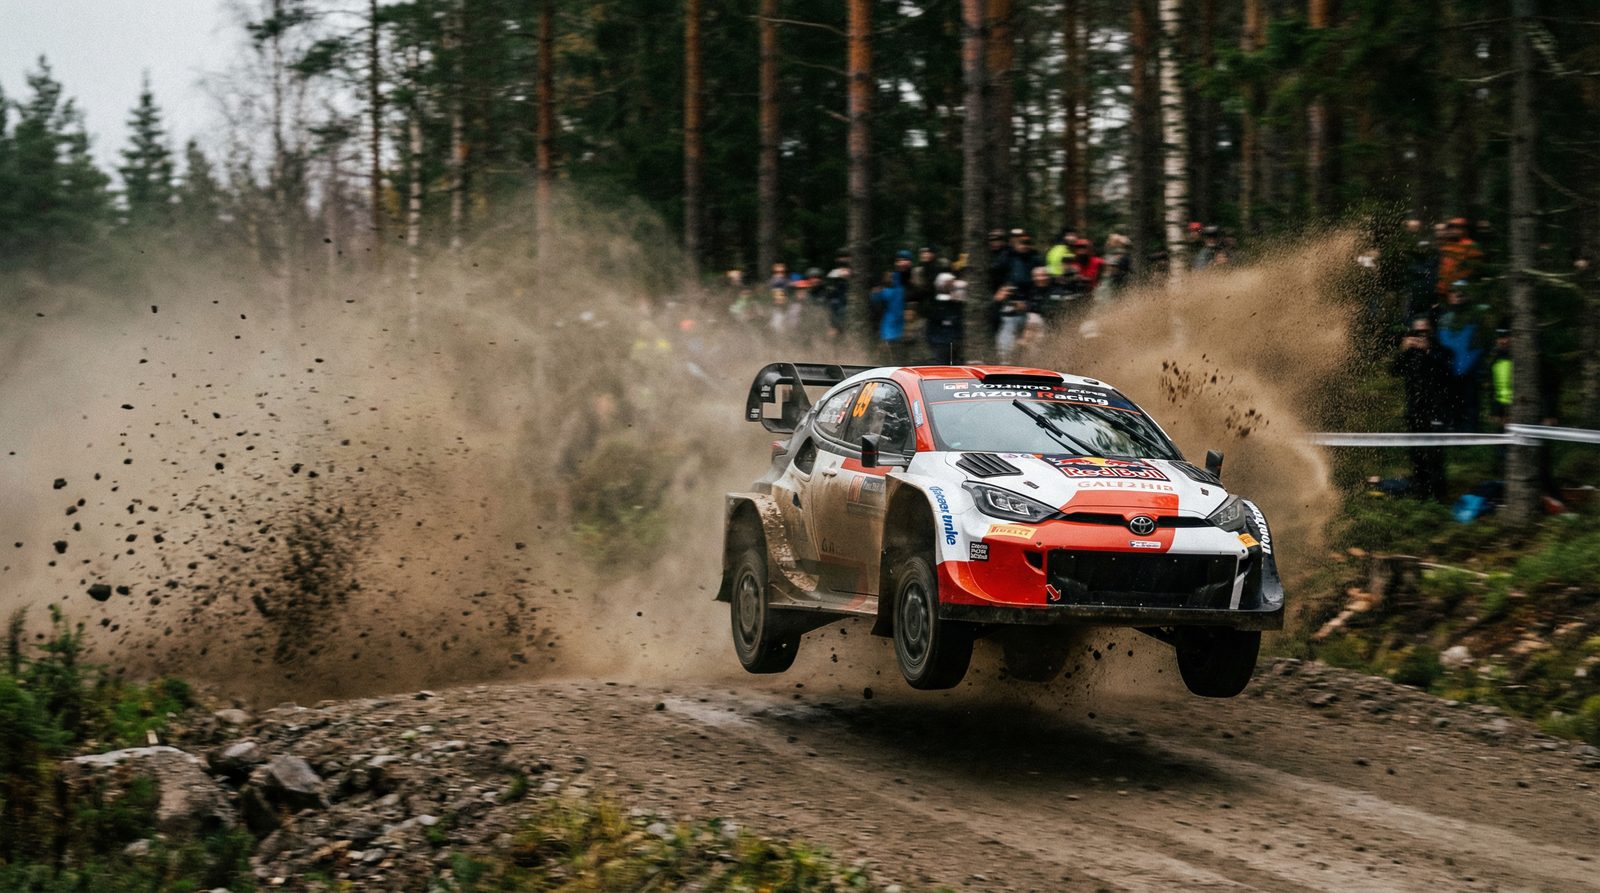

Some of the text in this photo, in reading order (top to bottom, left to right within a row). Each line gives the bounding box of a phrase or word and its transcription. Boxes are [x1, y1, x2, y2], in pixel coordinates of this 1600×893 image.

[953, 390, 1109, 406] GAZOO Racing
[1062, 466, 1165, 480] Red Bull
